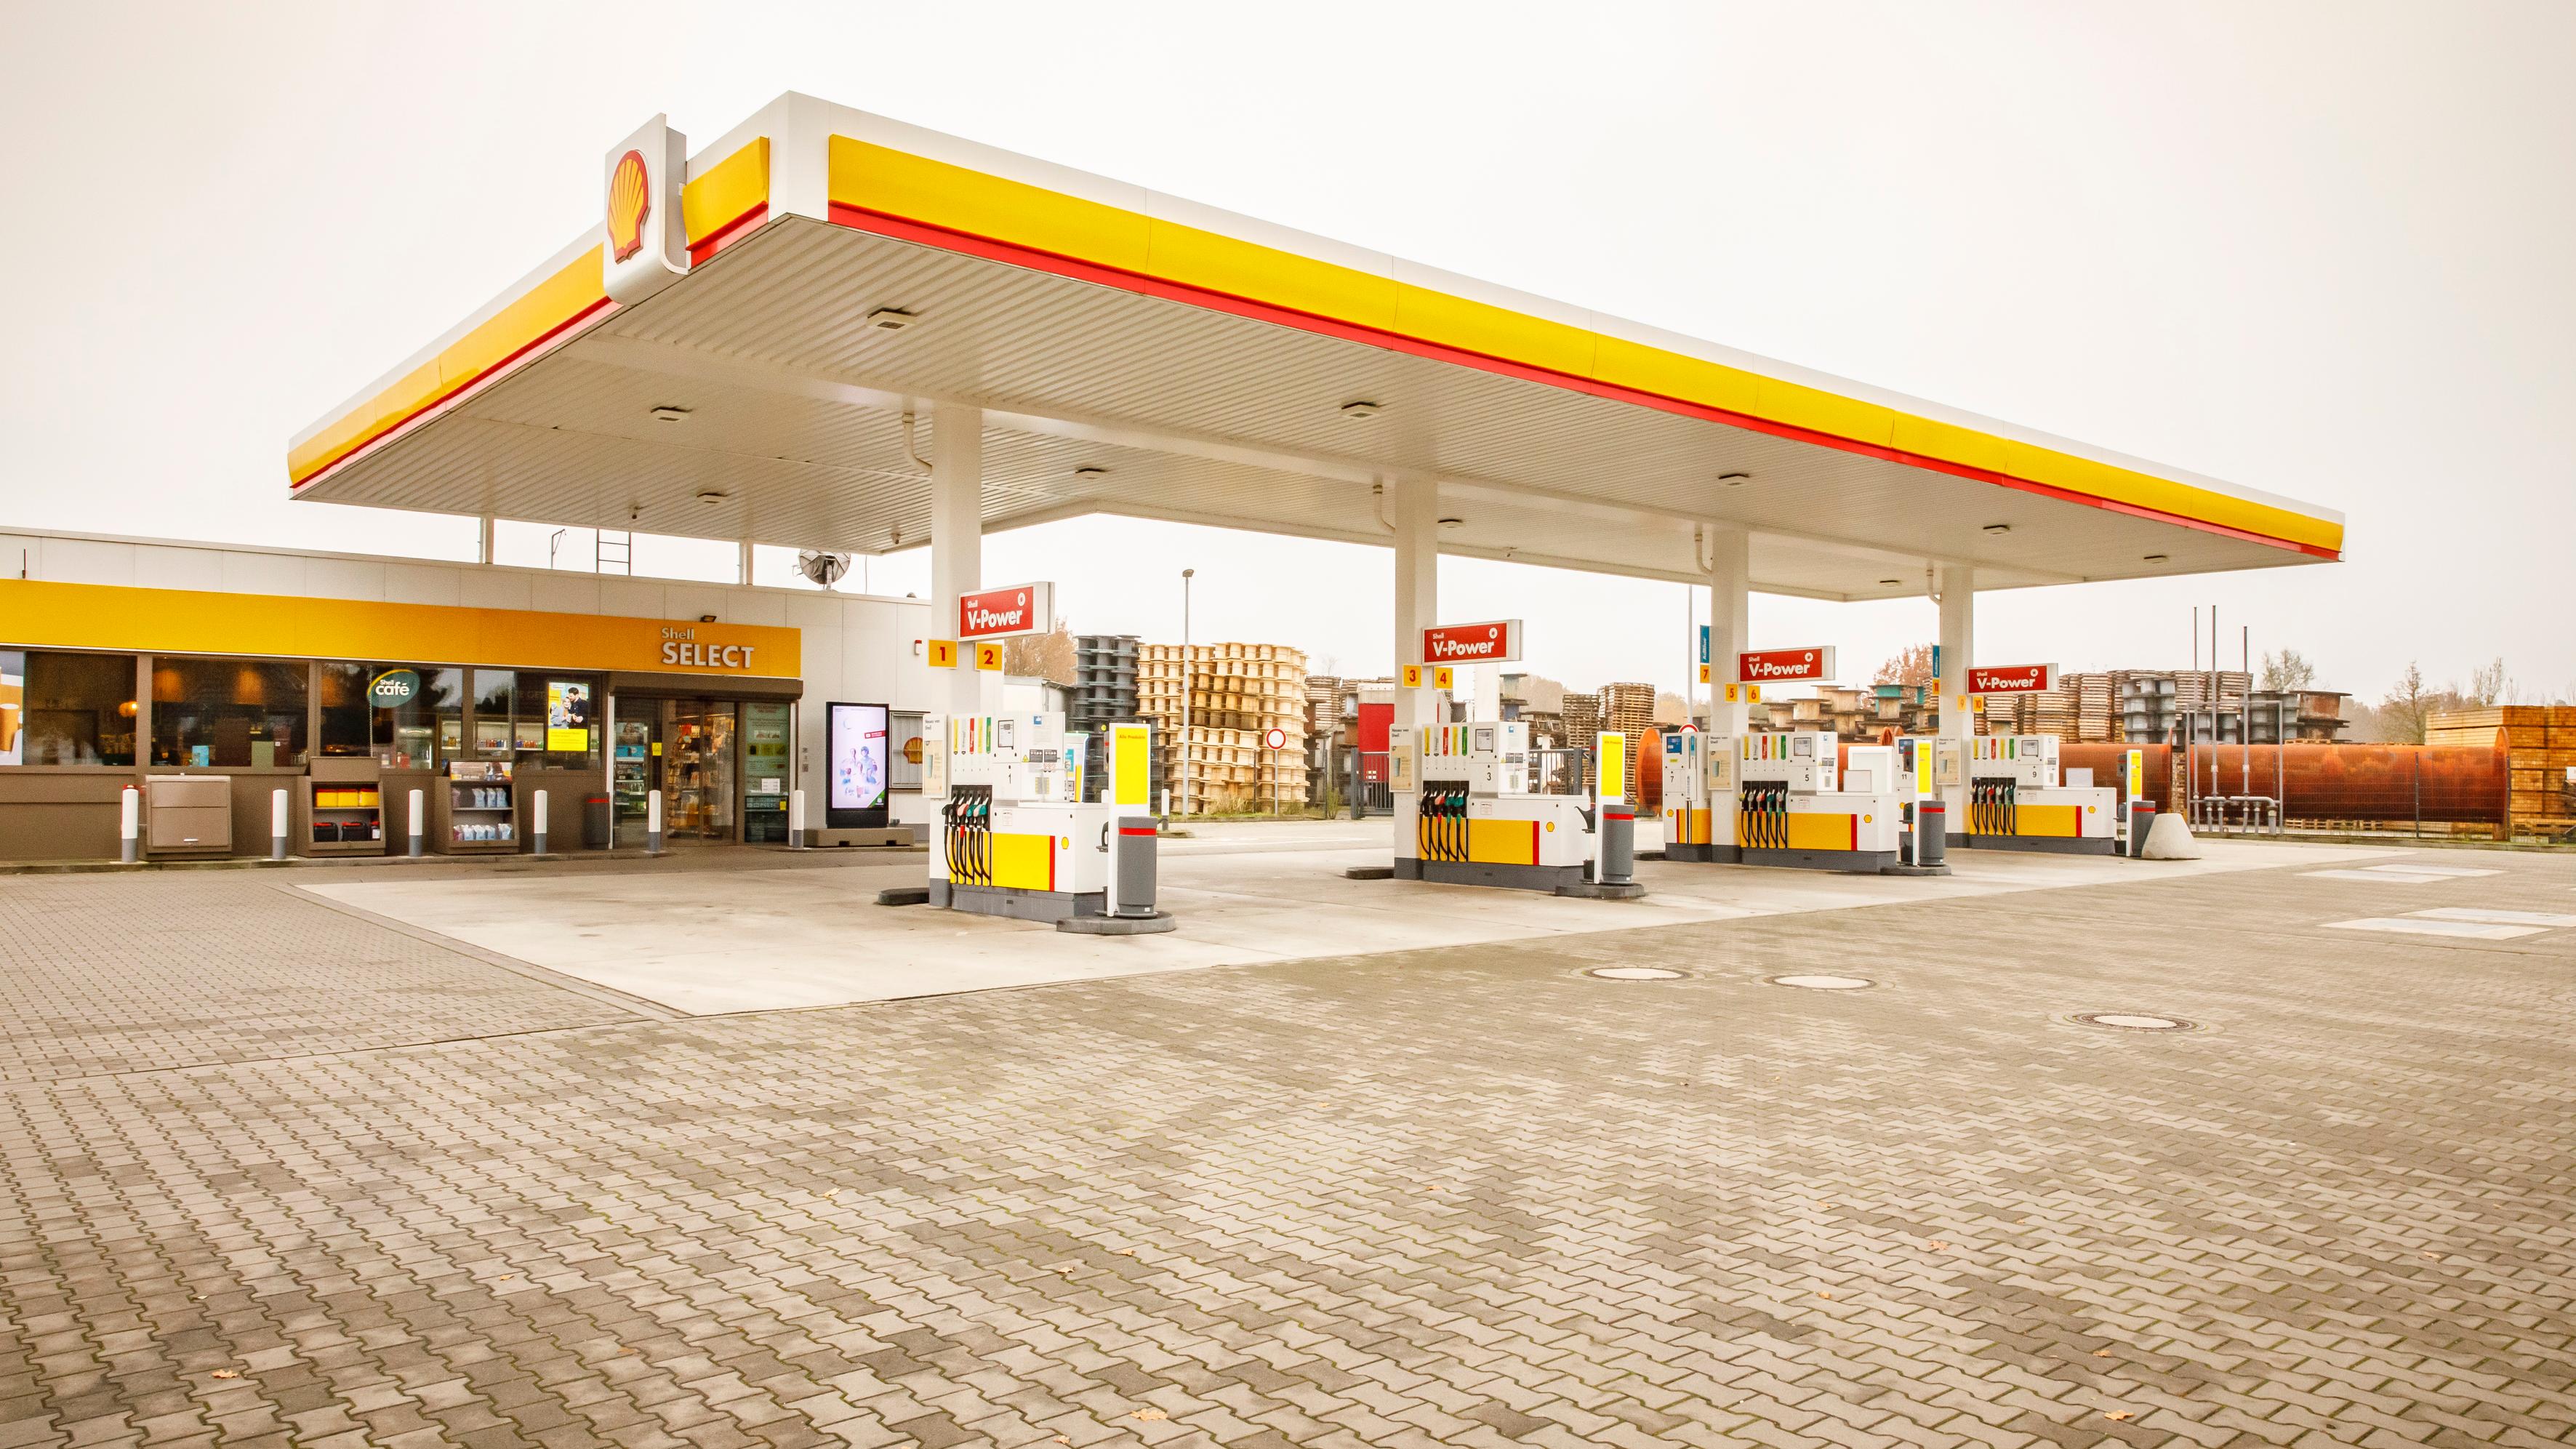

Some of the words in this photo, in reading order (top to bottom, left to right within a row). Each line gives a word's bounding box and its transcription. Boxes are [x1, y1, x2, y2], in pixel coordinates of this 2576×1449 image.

[968, 600, 978, 609] Shell
[968, 609, 1023, 630] V-Power
[662, 627, 694, 640] Shell
[939, 646, 946, 662] 1
[1432, 640, 1495, 657] V-Power
[662, 642, 755, 668] SELECT
[984, 649, 994, 665] 2
[1704, 669, 1709, 679] 7
[1748, 662, 1810, 677] V-Power
[1409, 670, 1416, 682] 3
[1440, 673, 1447, 684] 4
[375, 681, 410, 696] café
[1976, 677, 2036, 689] V-Power
[1730, 688, 1734, 698] 5
[1751, 689, 1757, 700] 6
[1008, 774, 1011, 784] 1
[1487, 772, 1491, 781] 3
